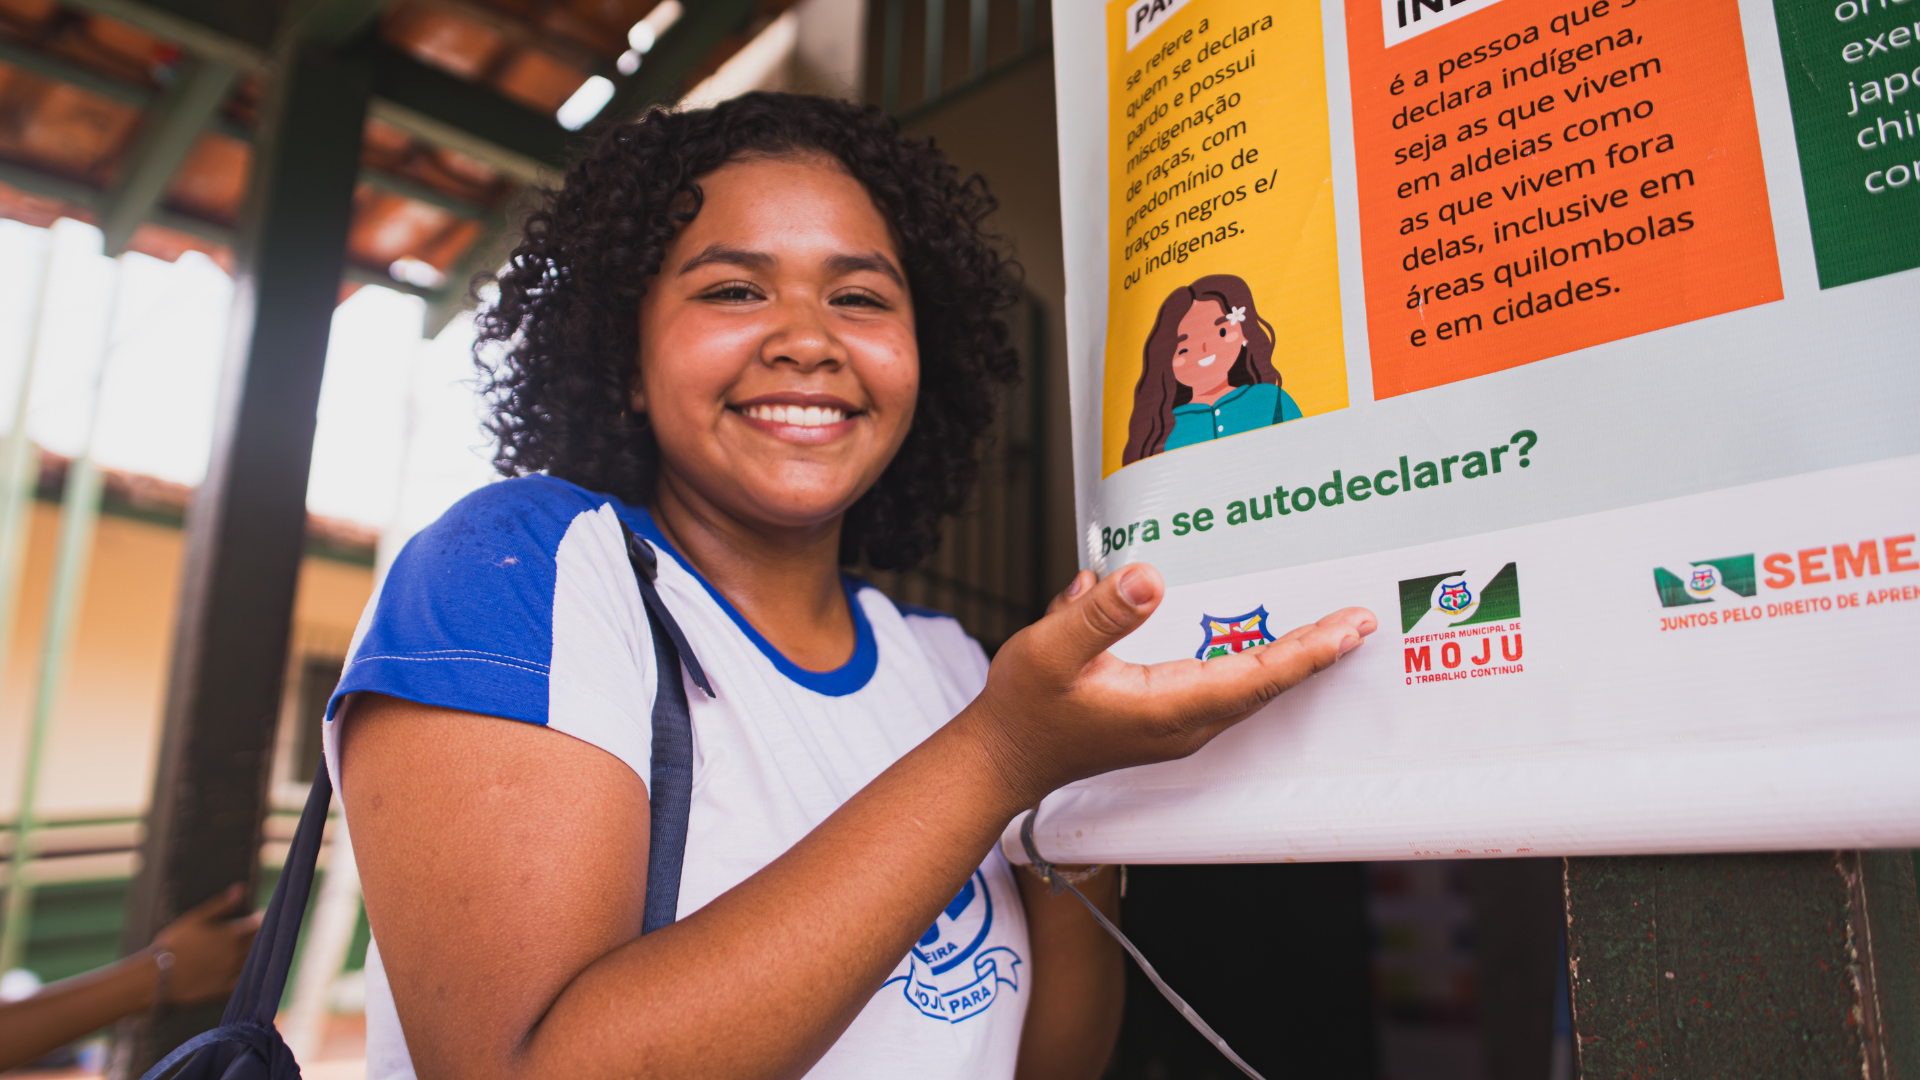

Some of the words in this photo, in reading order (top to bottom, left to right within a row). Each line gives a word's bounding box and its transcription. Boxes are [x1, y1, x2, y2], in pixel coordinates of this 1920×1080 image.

[1126, 69, 1142, 91] se
[1146, 29, 1193, 74] refere
[1198, 18, 1209, 34] a
[1135, 0, 1173, 34] PA
[1389, 73, 1405, 96] é
[1413, 69, 1429, 87] a
[1438, 25, 1540, 83] pessoa
[1550, 0, 1609, 36] que
[1397, 0, 1467, 28] IN
[1126, 75, 1168, 119] quem
[1172, 58, 1191, 80] se
[1197, 14, 1273, 63] declara
[1127, 101, 1168, 151] pardo
[1174, 92, 1184, 107] e
[1189, 50, 1255, 102] possui
[1392, 79, 1492, 130] declara
[1502, 27, 1643, 89] indígena,
[1126, 92, 1241, 175] miscigenação
[1394, 133, 1447, 166] seja
[1456, 117, 1488, 142] as
[1497, 94, 1555, 130] que
[1563, 57, 1662, 103] vivem
[1397, 171, 1441, 199] em
[1450, 132, 1553, 182] aldeias
[1563, 100, 1654, 143] como
[1857, 110, 1920, 149] chi
[1126, 180, 1142, 202] de
[1146, 146, 1195, 186] raças,
[1202, 120, 1247, 152] com
[1126, 163, 1223, 237] predomínio
[1231, 148, 1259, 170] de
[1399, 212, 1429, 236] as
[1438, 191, 1493, 226] que
[1501, 158, 1596, 201] vivem
[1605, 133, 1675, 169] fora
[1123, 267, 1140, 290] ou
[1145, 221, 1245, 274] indígenas.
[1125, 219, 1169, 261] traços
[1175, 185, 1247, 228] negros
[1254, 168, 1278, 193] e/
[1401, 234, 1484, 272] delas,
[1493, 188, 1629, 244] inclusive
[1640, 168, 1695, 200] em
[1406, 272, 1485, 310] áreas
[1493, 210, 1695, 288] quilombolas
[1409, 329, 1426, 347] e
[1436, 313, 1483, 341] em
[1492, 276, 1621, 325] cidades.
[1101, 518, 1160, 559] Bora
[1172, 508, 1214, 536] se
[1226, 429, 1538, 526] autodeclarar?
[1404, 631, 1456, 645] PREFEITURA
[1459, 625, 1506, 638] MUNICIPAL
[1509, 622, 1521, 631] DE
[1404, 633, 1523, 673] MOJU
[1660, 611, 1718, 632] JUNTOS
[1722, 605, 1762, 624] PELO
[1767, 597, 1832, 618] DIREITO
[1837, 592, 1860, 608] DE
[1406, 677, 1412, 685] O
[1415, 671, 1467, 684] TRABALHO
[1470, 664, 1523, 678] CONTINUA
